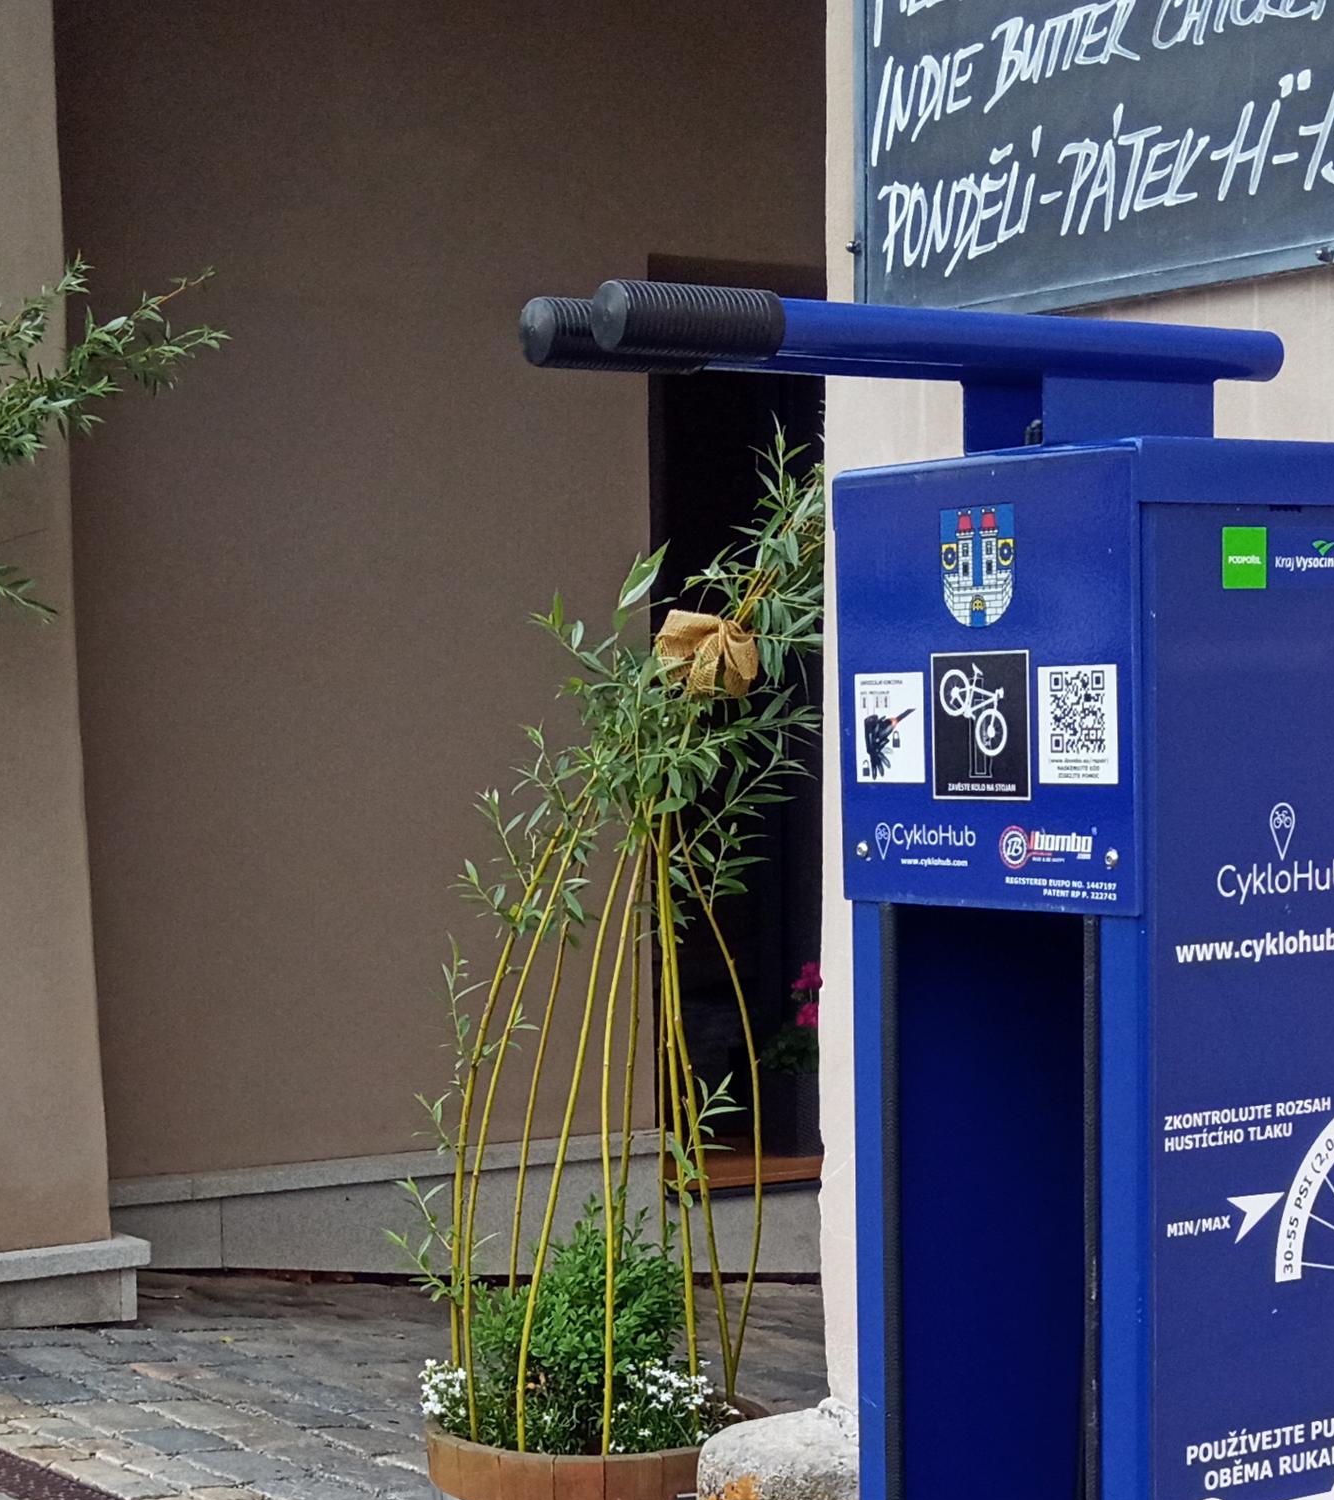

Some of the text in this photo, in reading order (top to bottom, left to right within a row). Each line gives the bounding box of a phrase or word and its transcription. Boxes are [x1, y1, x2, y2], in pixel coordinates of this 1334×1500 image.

[1275, 556, 1294, 572] Kraj
[892, 823, 976, 850] CykloHub
[901, 857, 968, 868] www.cyklohub.com
[1005, 876, 1047, 887] REGISTERED
[1043, 888, 1069, 898] PATENT
[1164, 1097, 1331, 1131] ZKONTROLUJTE ROZSAH
[1164, 1122, 1293, 1152] HUSTÍCÍHO TLAKU
[1167, 1215, 1231, 1238] MIN/MAX
[1283, 1216, 1300, 1274] 30-55
[1294, 1178, 1313, 1210] PSI
[1186, 1424, 1305, 1466] POUŽÍVEJTE
[1204, 1459, 1273, 1491] OBĚMA
